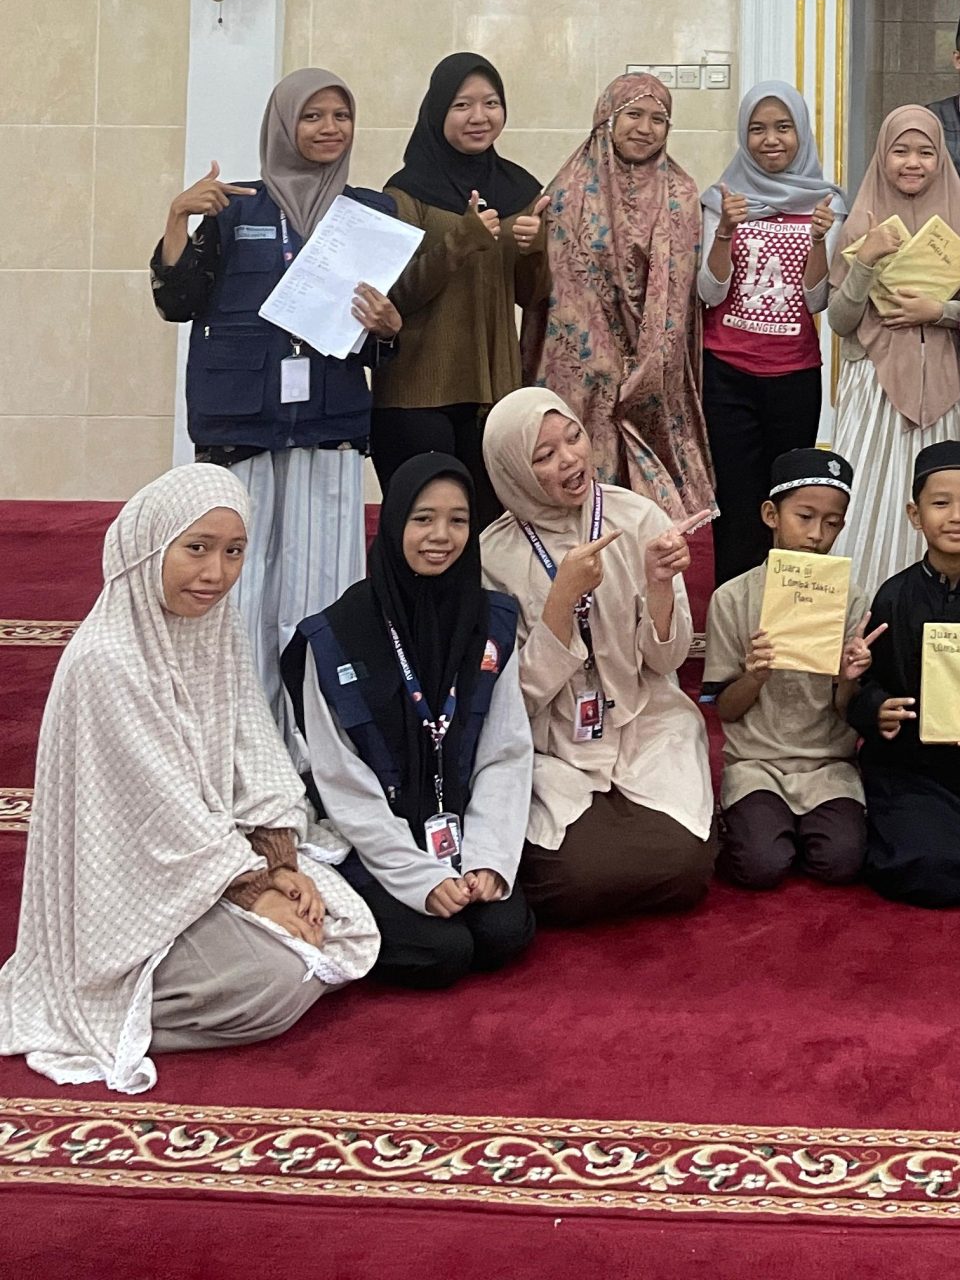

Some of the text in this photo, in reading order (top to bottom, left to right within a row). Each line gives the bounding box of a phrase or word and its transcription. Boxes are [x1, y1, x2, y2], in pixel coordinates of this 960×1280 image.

[747, 221, 807, 233] CALIFORNIA
[732, 318, 788, 334] LOS ANGELES
